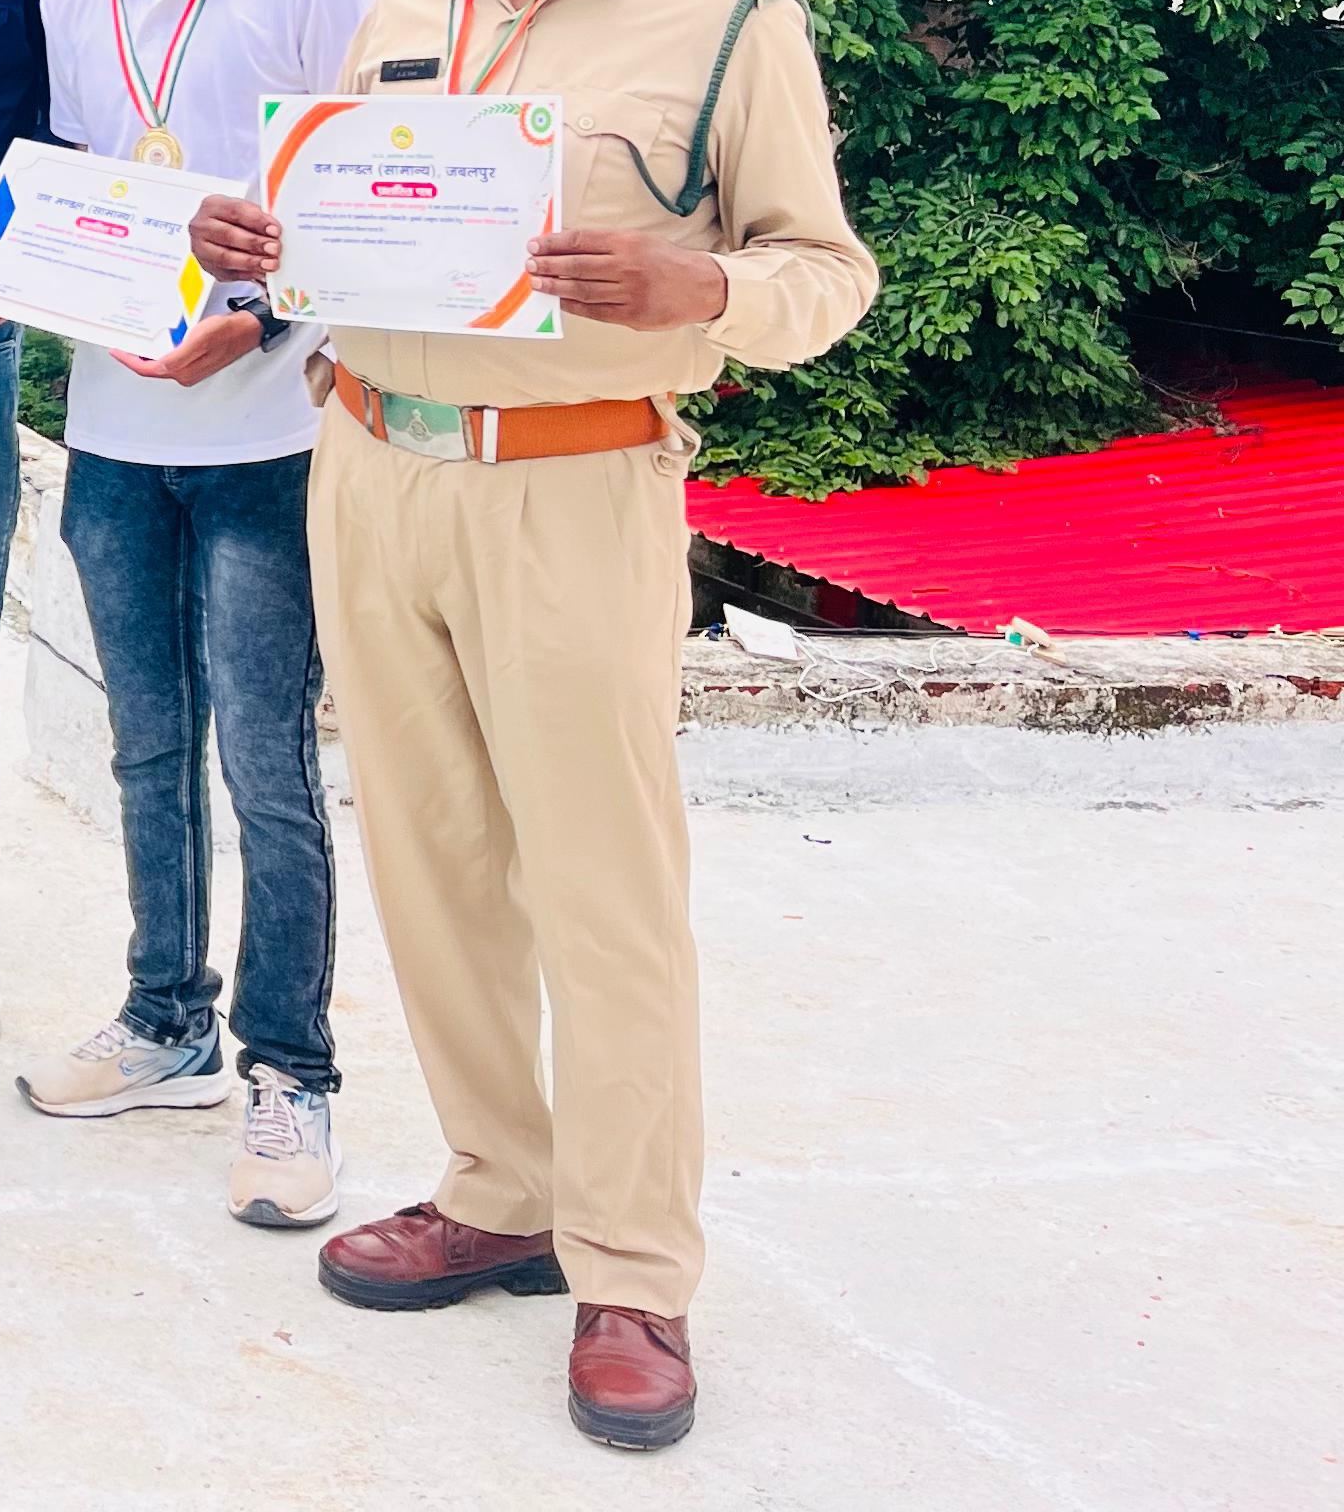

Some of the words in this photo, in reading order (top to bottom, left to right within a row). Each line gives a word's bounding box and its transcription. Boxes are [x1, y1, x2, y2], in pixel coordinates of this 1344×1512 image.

[313, 163, 332, 174] वन
[336, 163, 373, 175] मण्डल
[445, 166, 498, 183] जबलपुर
